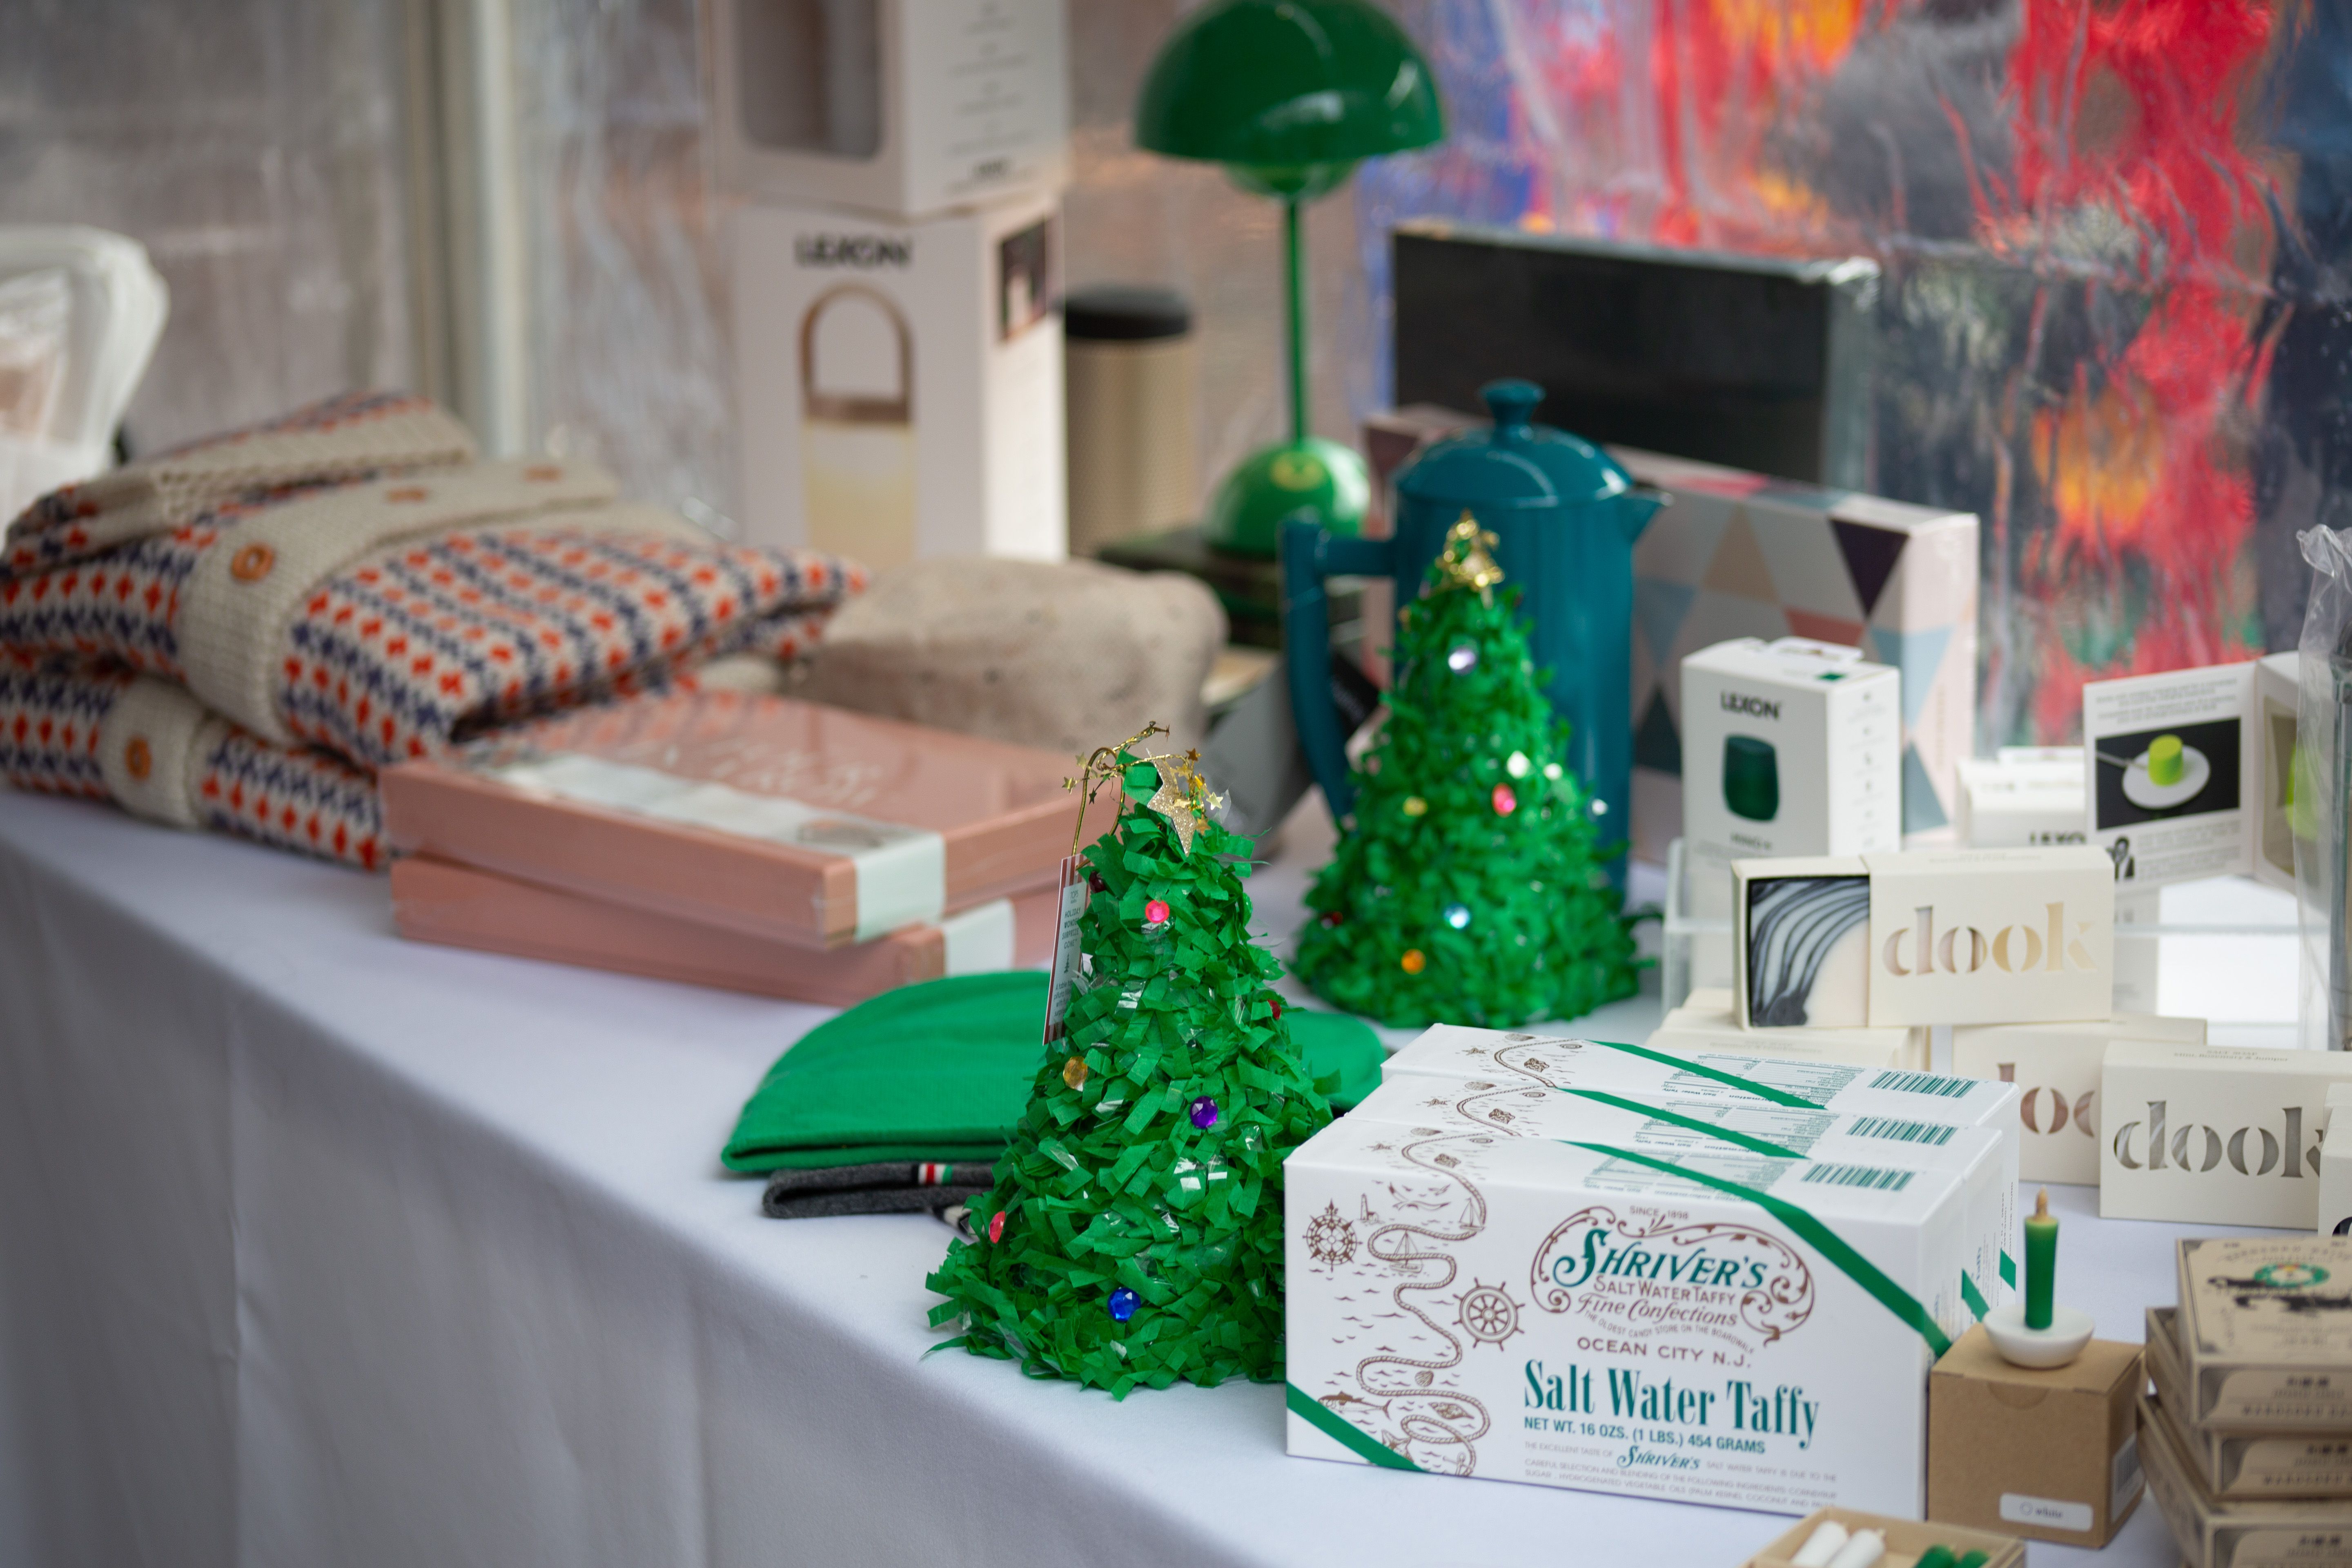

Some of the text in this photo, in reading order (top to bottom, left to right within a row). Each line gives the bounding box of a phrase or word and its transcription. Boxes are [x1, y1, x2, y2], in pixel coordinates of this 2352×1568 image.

[1719, 693, 1781, 720] LEXON
[1070, 890, 1078, 899] TOPS
[1064, 907, 1081, 918] HOLIDAY
[1064, 918, 1079, 929] WONDE
[1062, 927, 1079, 940] SURPRIZE
[1881, 902, 2098, 977] dook
[1630, 1205, 1659, 1216] SINCE
[1553, 1227, 1767, 1289] SHRIVER'S
[1594, 1275, 1735, 1305] SALT WATER TAFFY
[1575, 1292, 1738, 1325] Fine Confections
[1584, 1310, 1597, 1322] THE
[1598, 1318, 1626, 1335] OLDEST
[1628, 1327, 1652, 1339] CANDY
[1655, 1324, 1678, 1334] STORE
[1695, 1324, 1708, 1334] THE
[1711, 1328, 1755, 1354] BOARDWALK
[1577, 1336, 1751, 1368] OCEAN CITY N.J.
[1524, 1359, 1820, 1450] Salt Water Taffy
[1524, 1417, 1766, 1454] NET WT. 16 OZS. (1 LBS.) 454 GRAMS
[1525, 1441, 1537, 1450] THE
[1539, 1442, 1579, 1454] EXCELLENT
[1581, 1448, 1601, 1457] TASTE
[1602, 1449, 1613, 1457] OF
[1616, 1445, 1701, 1470] SHRIVER'S
[1706, 1460, 1724, 1469] SALT
[1726, 1462, 1753, 1472] WATER
[1524, 1458, 1557, 1469] CAREFUL
[1559, 1461, 1599, 1474] SELECTION
[1601, 1467, 1618, 1475] AND
[1687, 1476, 1734, 1488] FOLLOWING
